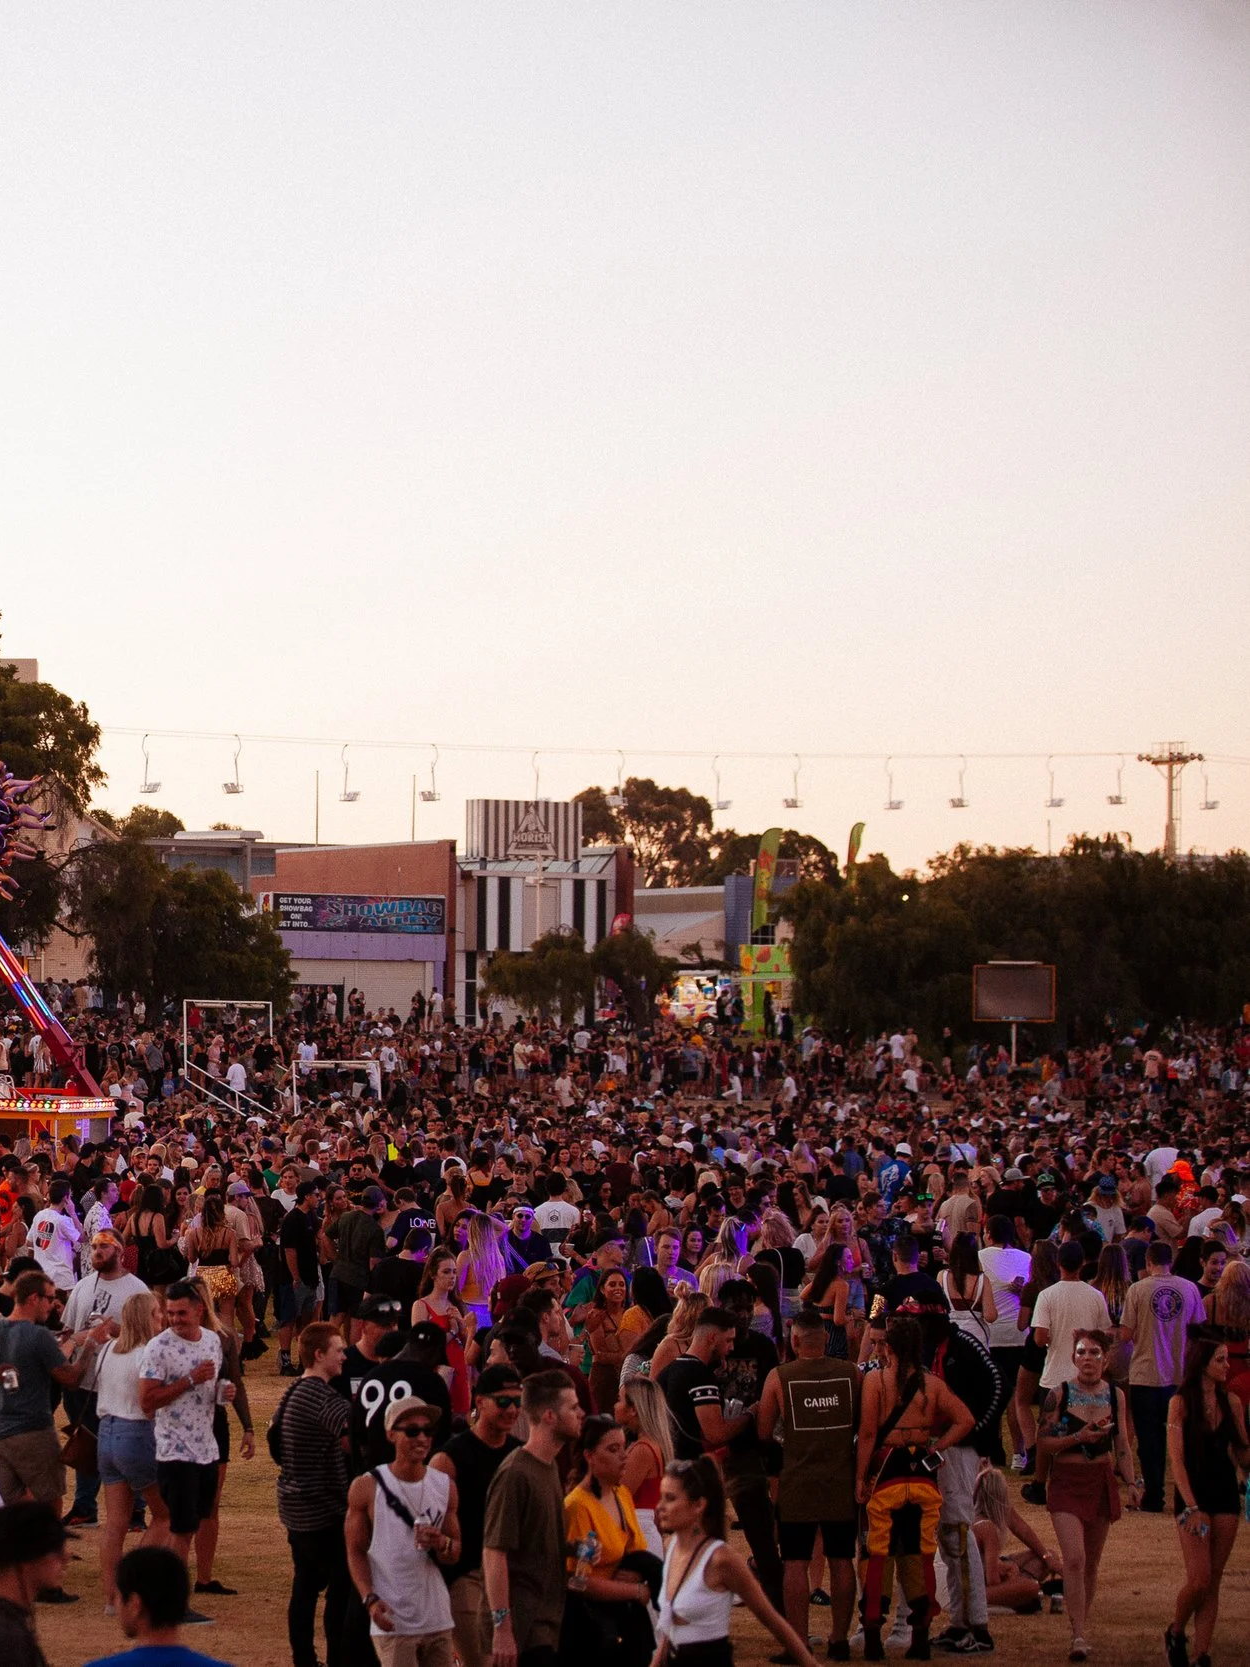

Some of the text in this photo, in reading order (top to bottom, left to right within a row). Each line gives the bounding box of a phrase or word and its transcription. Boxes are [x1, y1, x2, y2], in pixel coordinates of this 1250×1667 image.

[513, 832, 551, 843] MORISH
[327, 900, 443, 917] SHOWBAG
[359, 915, 441, 926] ALLEY
[804, 1394, 839, 1408] CARRÉ
